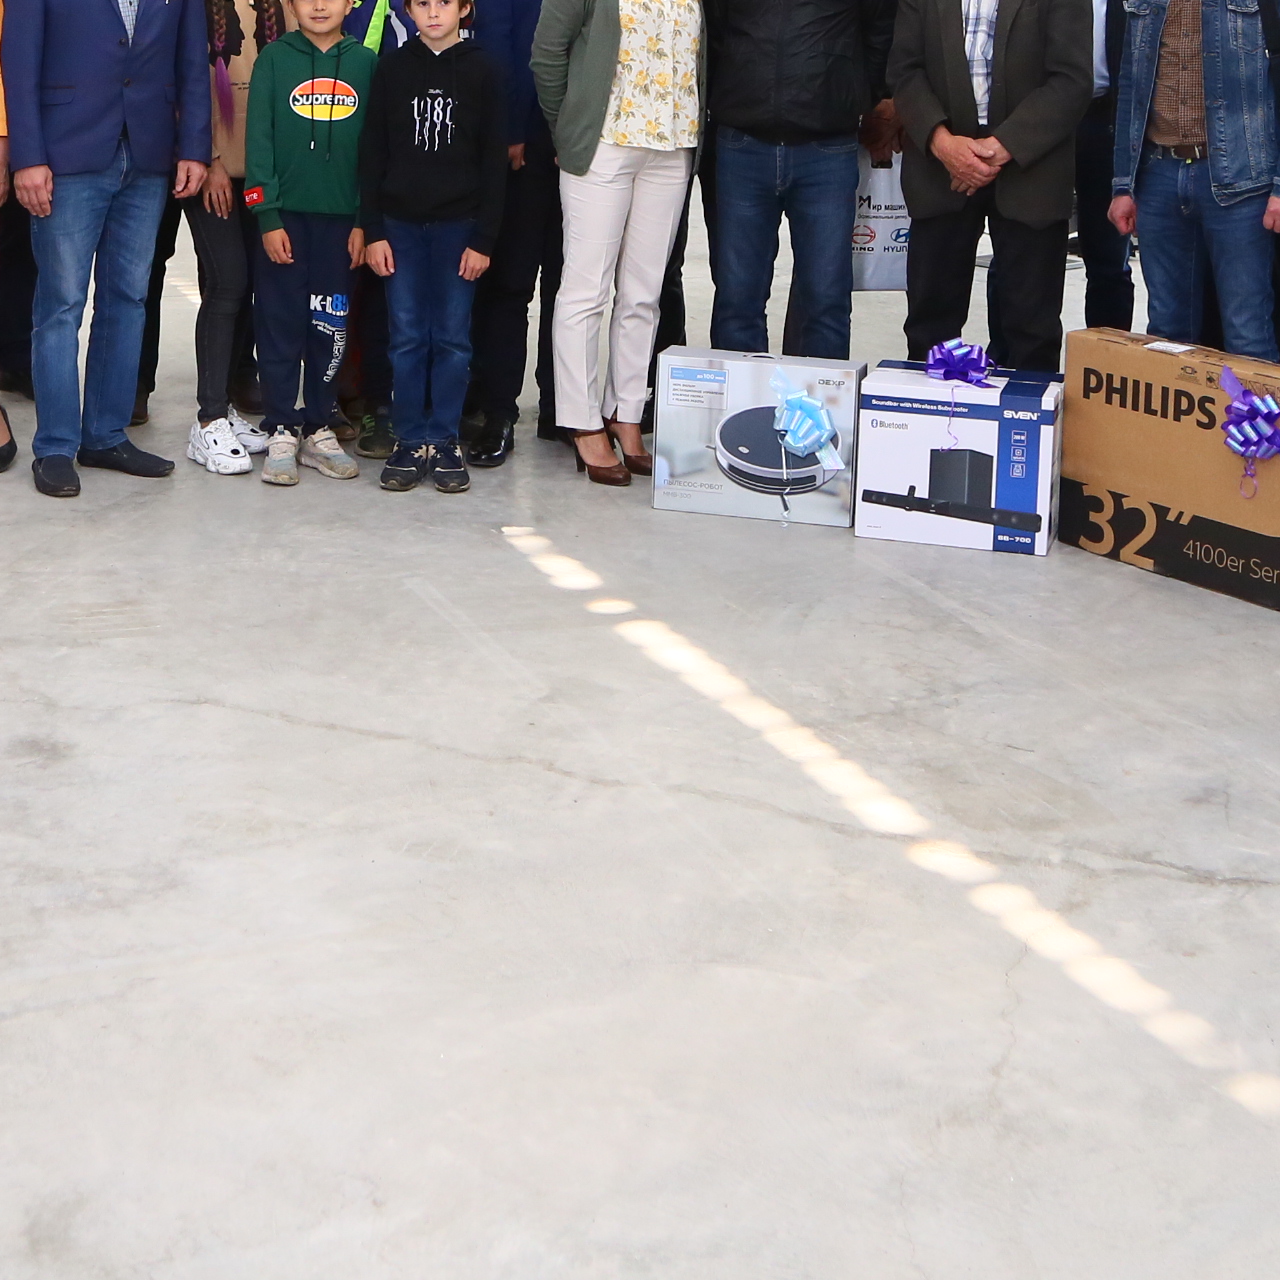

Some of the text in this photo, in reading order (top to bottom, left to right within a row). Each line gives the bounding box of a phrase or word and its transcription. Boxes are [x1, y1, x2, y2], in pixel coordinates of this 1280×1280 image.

[293, 90, 356, 107] Supreme
[858, 195, 882, 213] Мир
[883, 245, 908, 253] HYUN
[818, 378, 846, 387] DEXP
[871, 399, 899, 407] Soundbar
[912, 402, 937, 410] Wireless
[1082, 367, 1217, 431] PHILIPS
[1003, 410, 1038, 421] SVEN
[879, 420, 909, 431] Bluetooth
[663, 478, 724, 491] ПЫЛЕСОС-РОБОТ
[997, 534, 1032, 544] SB-700
[1183, 539, 1245, 574] 4100er
